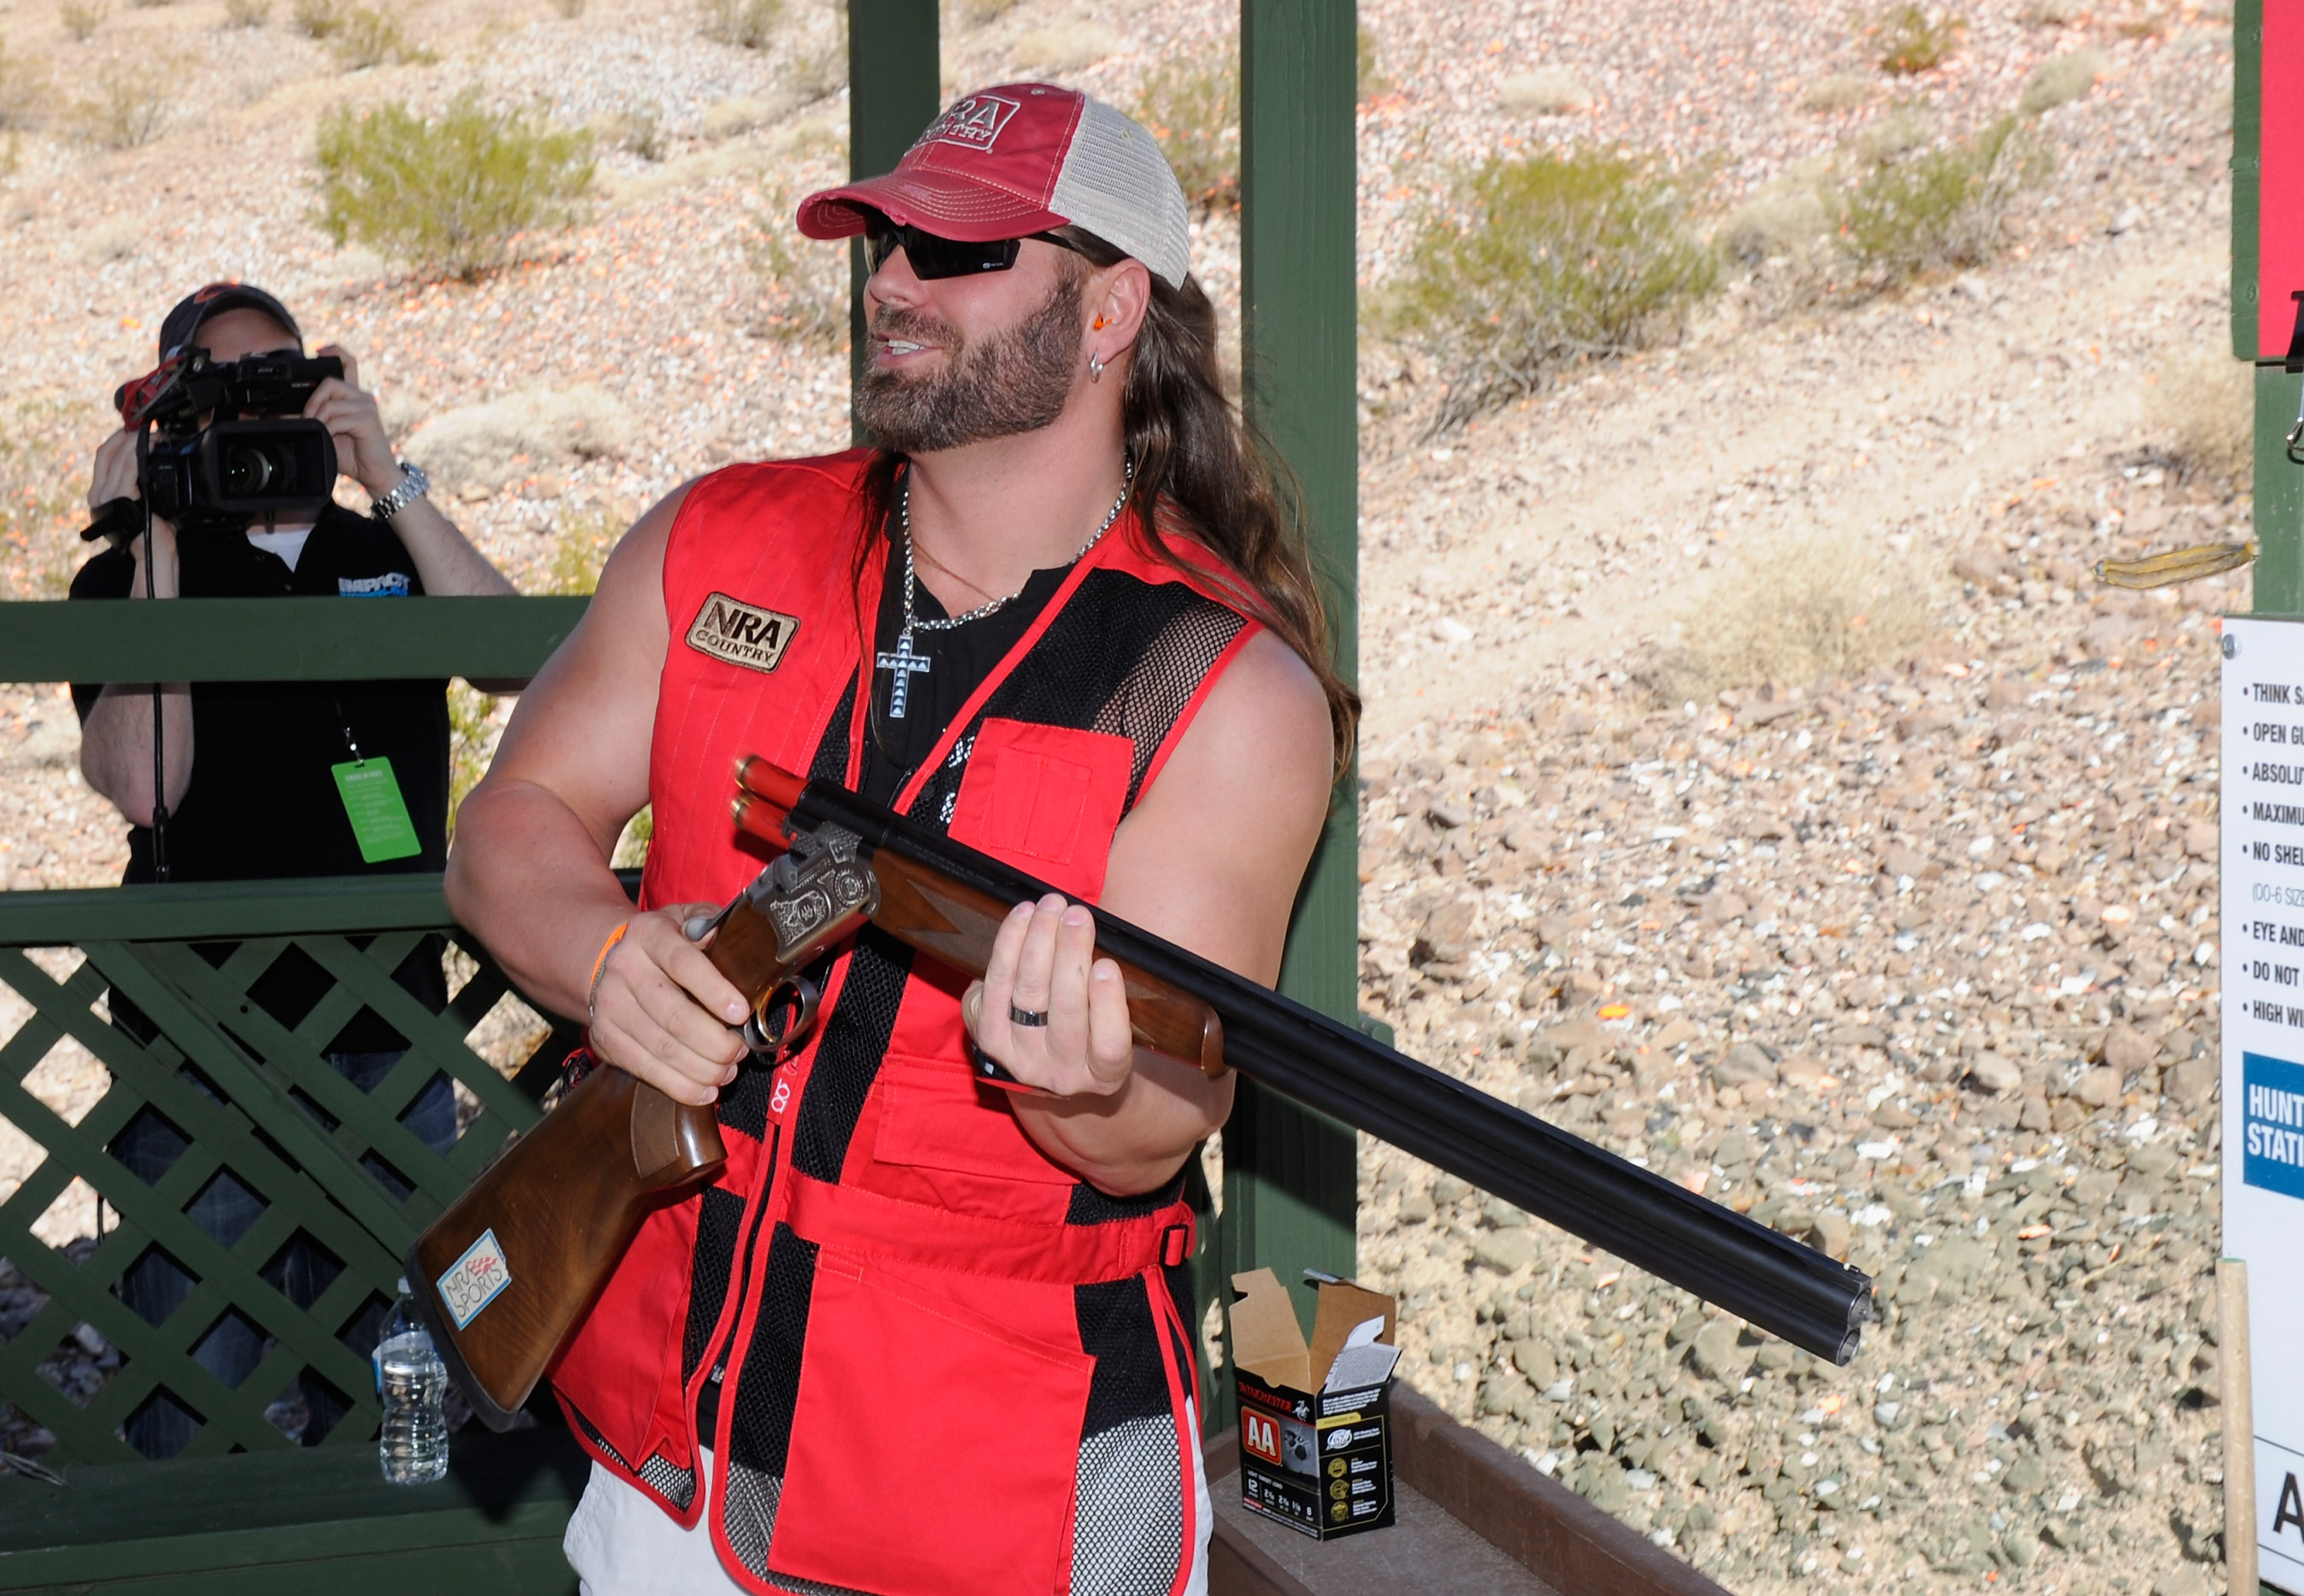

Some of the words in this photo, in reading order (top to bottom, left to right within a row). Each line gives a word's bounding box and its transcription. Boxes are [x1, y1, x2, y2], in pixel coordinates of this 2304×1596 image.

[703, 601, 781, 650] NRA
[695, 630, 776, 662] COUNTRY
[2253, 683, 2290, 704] THINK
[2294, 685, 2304, 706] S
[2253, 722, 2286, 743] OPEN
[2253, 841, 2270, 861] NO
[2253, 921, 2276, 942] EYE
[2279, 925, 2304, 947] AND
[2253, 960, 2270, 982] DO
[2275, 964, 2299, 987] NOT
[2253, 999, 2282, 1024] HIGH
[2249, 1083, 2304, 1127] HUNT
[2247, 1121, 2304, 1167] STATI
[454, 1268, 502, 1318] SPORTS
[1239, 1382, 1293, 1412] WINCHESTER
[1248, 1416, 1276, 1457] AA
[1248, 1478, 1258, 1493] 12
[2273, 1471, 2304, 1545] A
